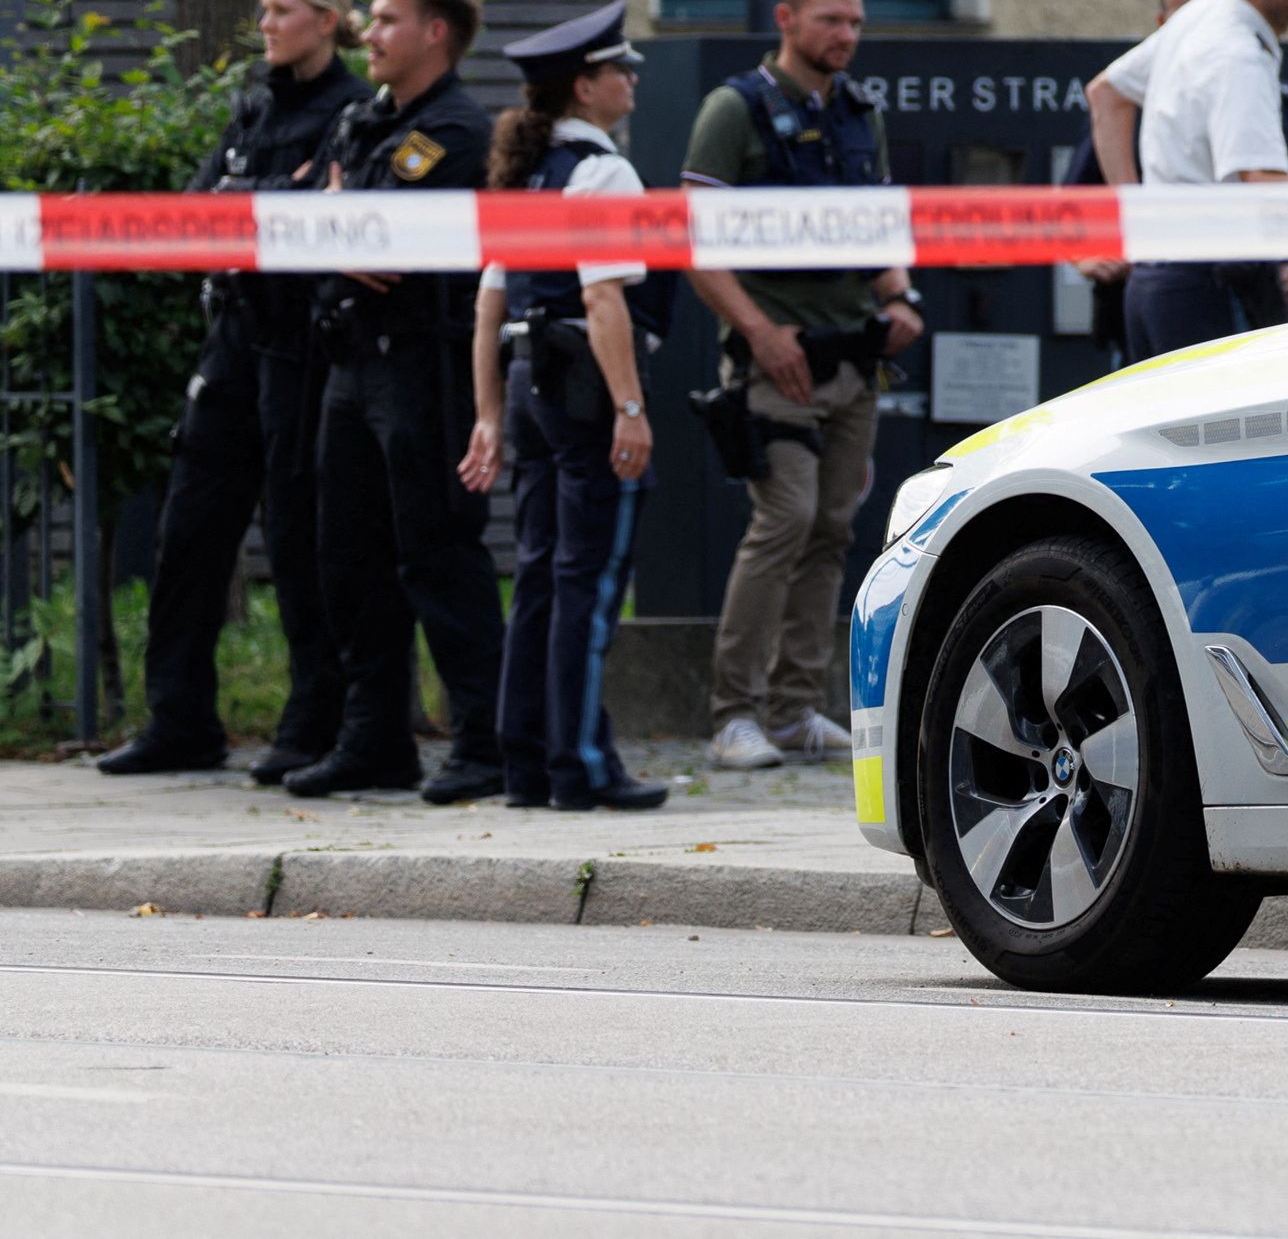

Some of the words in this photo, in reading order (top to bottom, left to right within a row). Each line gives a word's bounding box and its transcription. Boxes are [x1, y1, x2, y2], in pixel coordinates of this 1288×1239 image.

[864, 75, 955, 112] RER
[972, 75, 1089, 112] STRA
[630, 201, 1086, 248] POLIZEIABSPERRUNG
